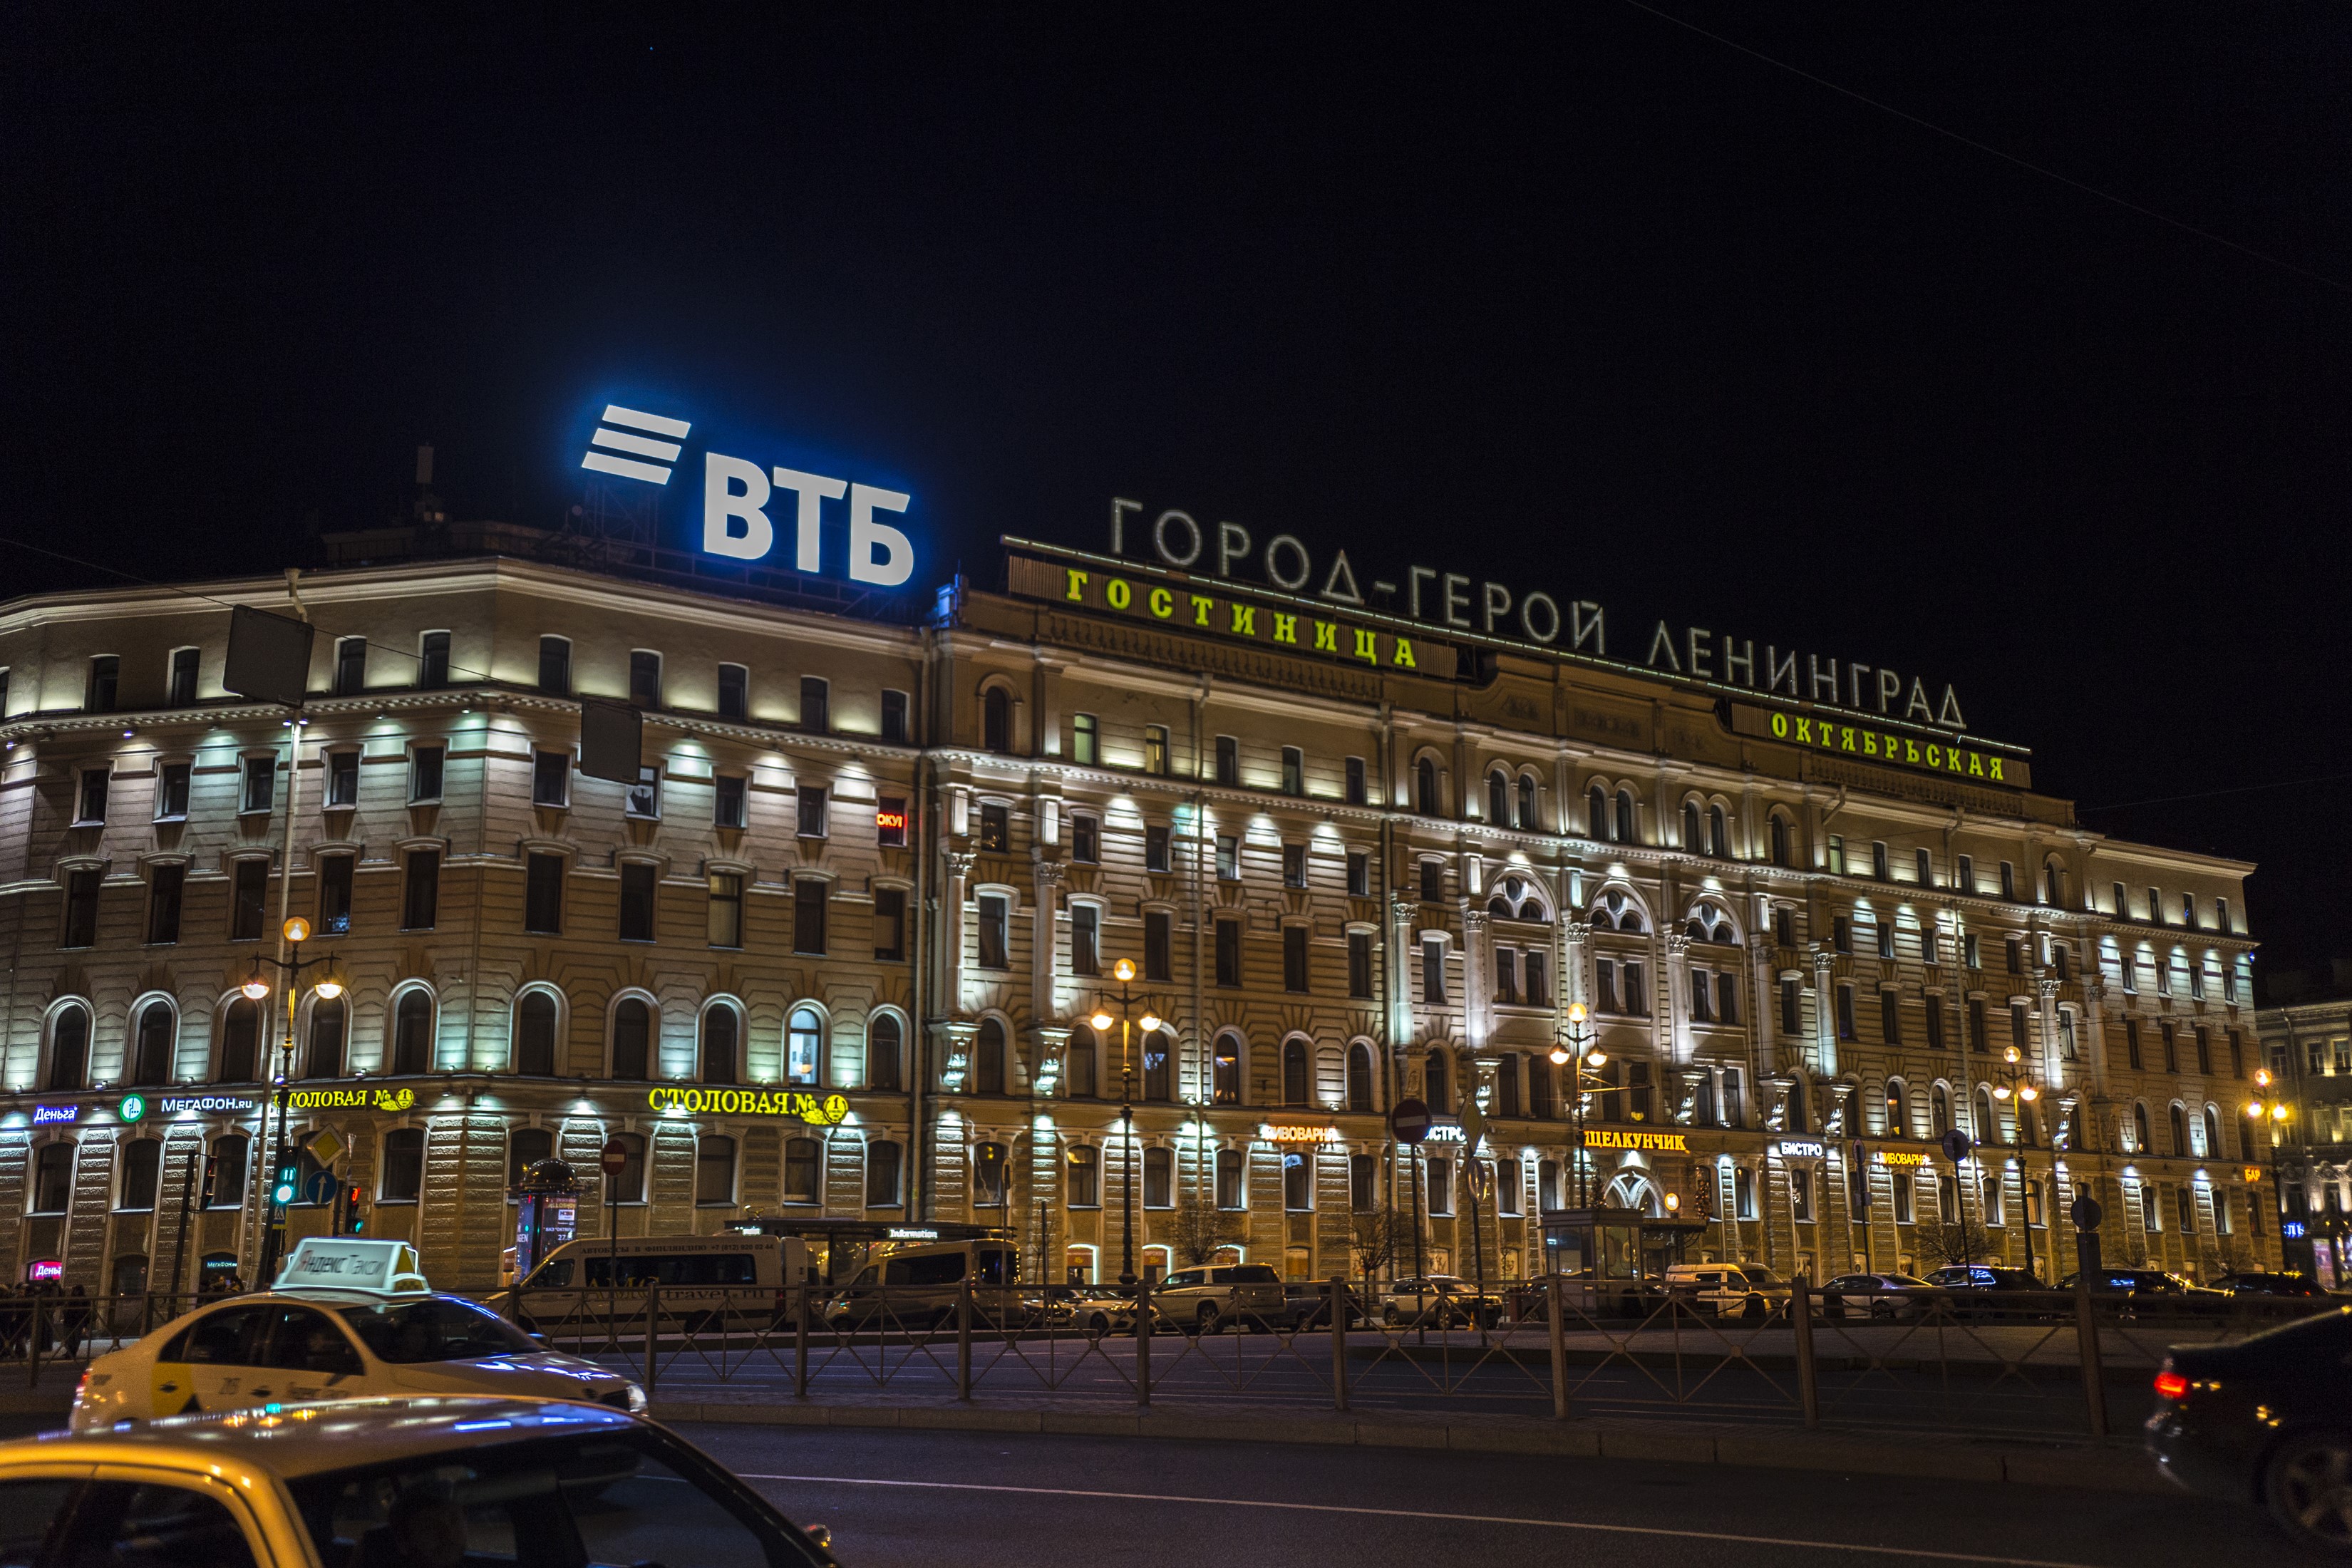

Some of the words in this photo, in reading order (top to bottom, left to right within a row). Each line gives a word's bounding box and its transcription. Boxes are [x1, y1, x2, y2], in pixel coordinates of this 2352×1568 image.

[704, 451, 914, 587] ВТБ
[1066, 567, 1417, 667] ГОСТИНИЦА
[1111, 497, 1605, 656] ГОРОД-ГЕРОЙ
[1647, 619, 1967, 731] ЛЕНИНГРАД
[1770, 712, 2006, 781] ОКТЯБРЬСКАЯ
[34, 1105, 77, 1122] Деньга
[648, 1088, 790, 1115] СТОЛОВАЯ
[1584, 1130, 1687, 1151] ЩЕЛКУНЧИК
[1781, 1142, 1823, 1156] БИСТРО
[2245, 1167, 2261, 1181] БАР
[296, 1250, 348, 1281] Яндекс
